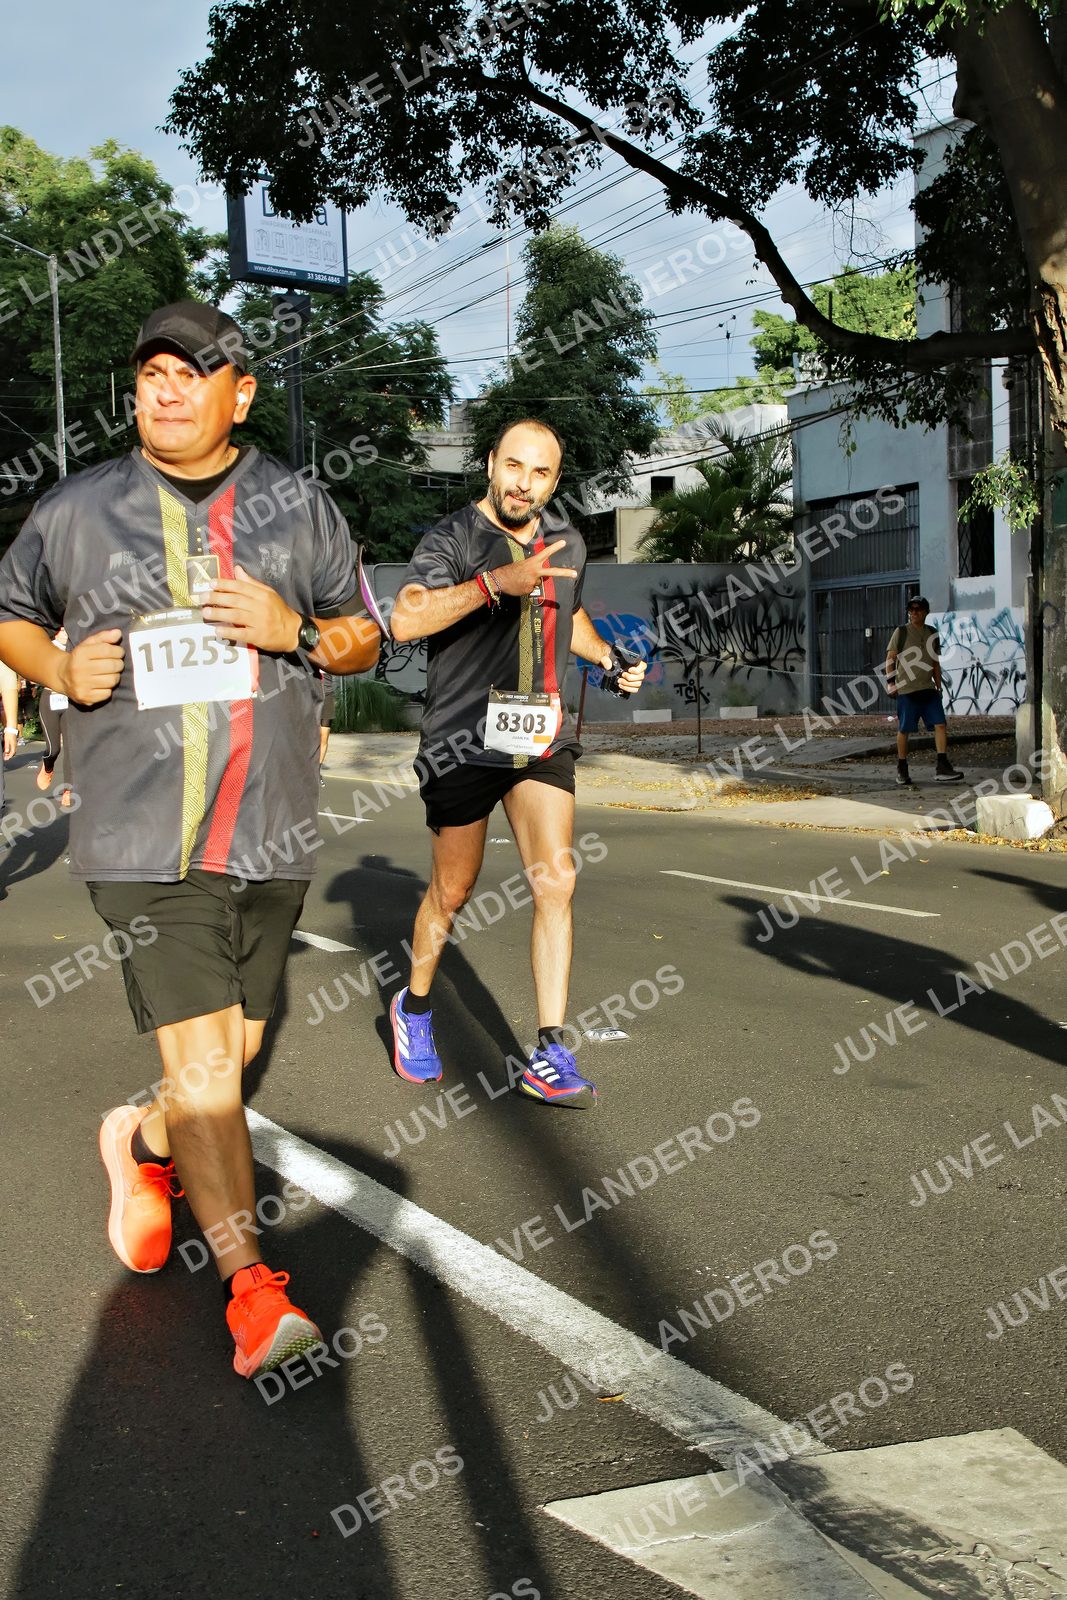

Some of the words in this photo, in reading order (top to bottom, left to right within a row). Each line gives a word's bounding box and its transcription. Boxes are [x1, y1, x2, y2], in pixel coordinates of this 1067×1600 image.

[307, 272, 315, 280] 33
[138, 635, 240, 672] 11253
[495, 711, 546, 734] 8303
